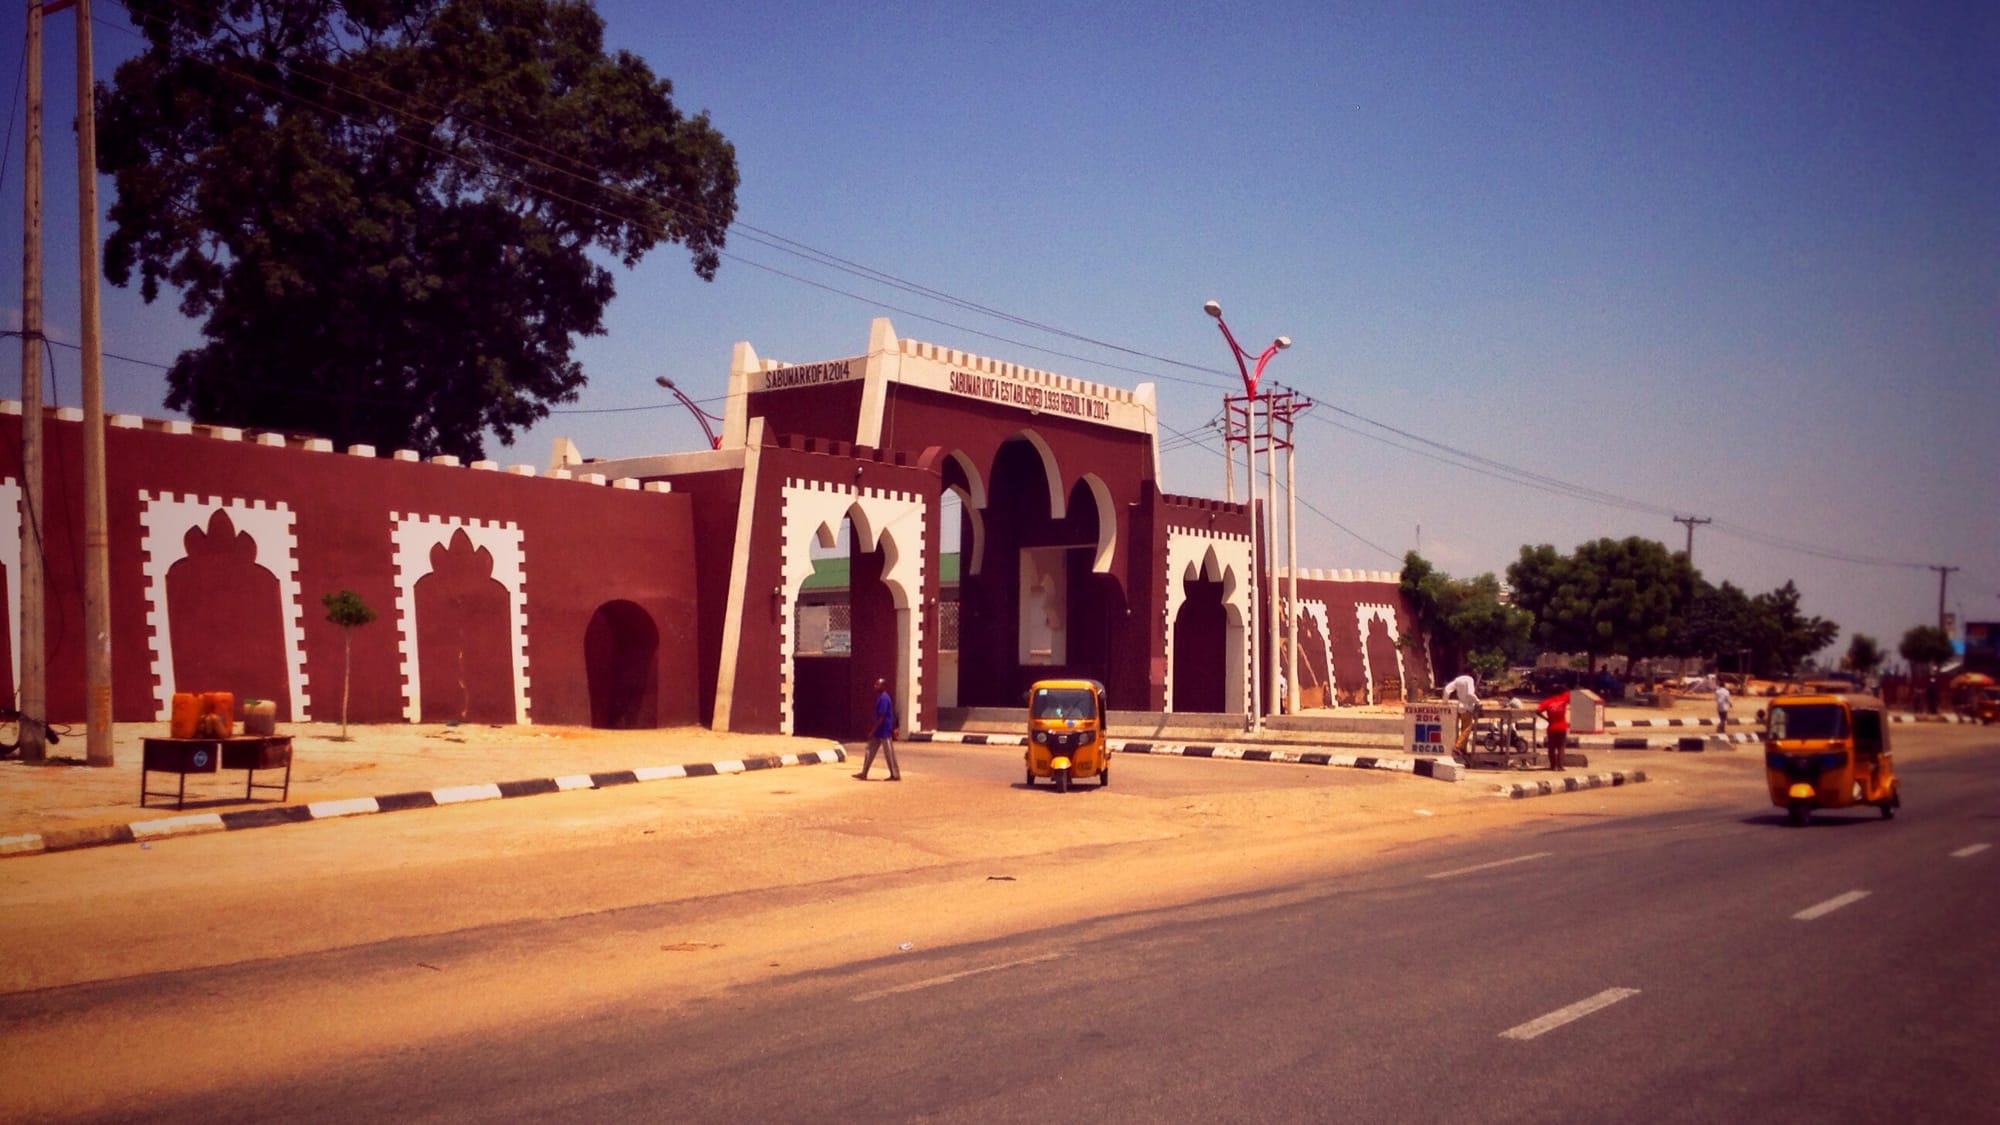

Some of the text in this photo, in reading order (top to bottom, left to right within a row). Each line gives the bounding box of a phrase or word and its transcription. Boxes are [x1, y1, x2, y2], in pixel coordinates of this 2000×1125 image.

[1001, 381, 1043, 408] ESTABLISHED
[1061, 393, 1086, 417] REBUILT
[1086, 398, 1093, 417] IN
[1093, 400, 1109, 421] 2014
